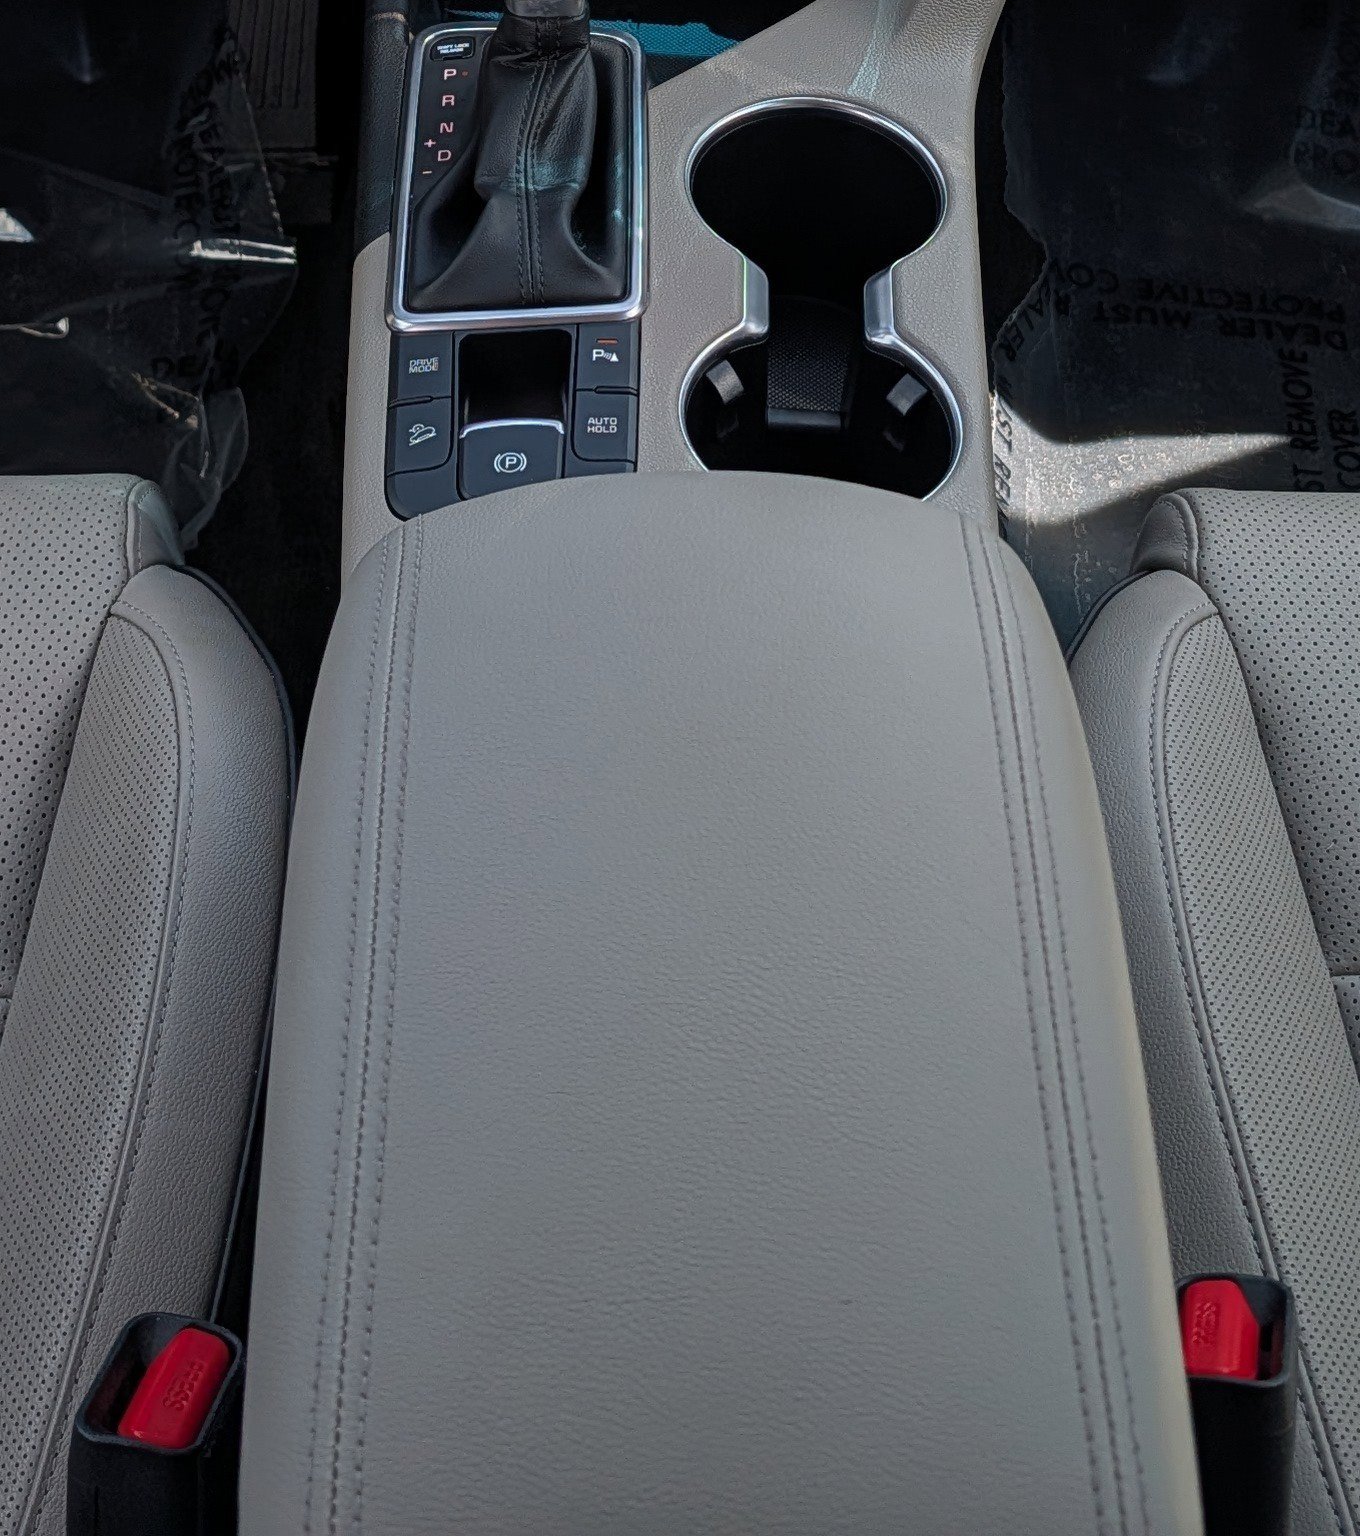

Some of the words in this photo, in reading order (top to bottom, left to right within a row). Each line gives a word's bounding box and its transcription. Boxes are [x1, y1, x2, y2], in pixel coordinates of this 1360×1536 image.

[443, 69, 457, 80] P
[442, 95, 455, 107] R
[440, 121, 454, 134] N
[437, 149, 452, 162] D
[409, 357, 439, 366] DRIVE
[408, 365, 439, 374] MODE
[587, 417, 617, 426] AUTO
[587, 425, 617, 434] HOLD
